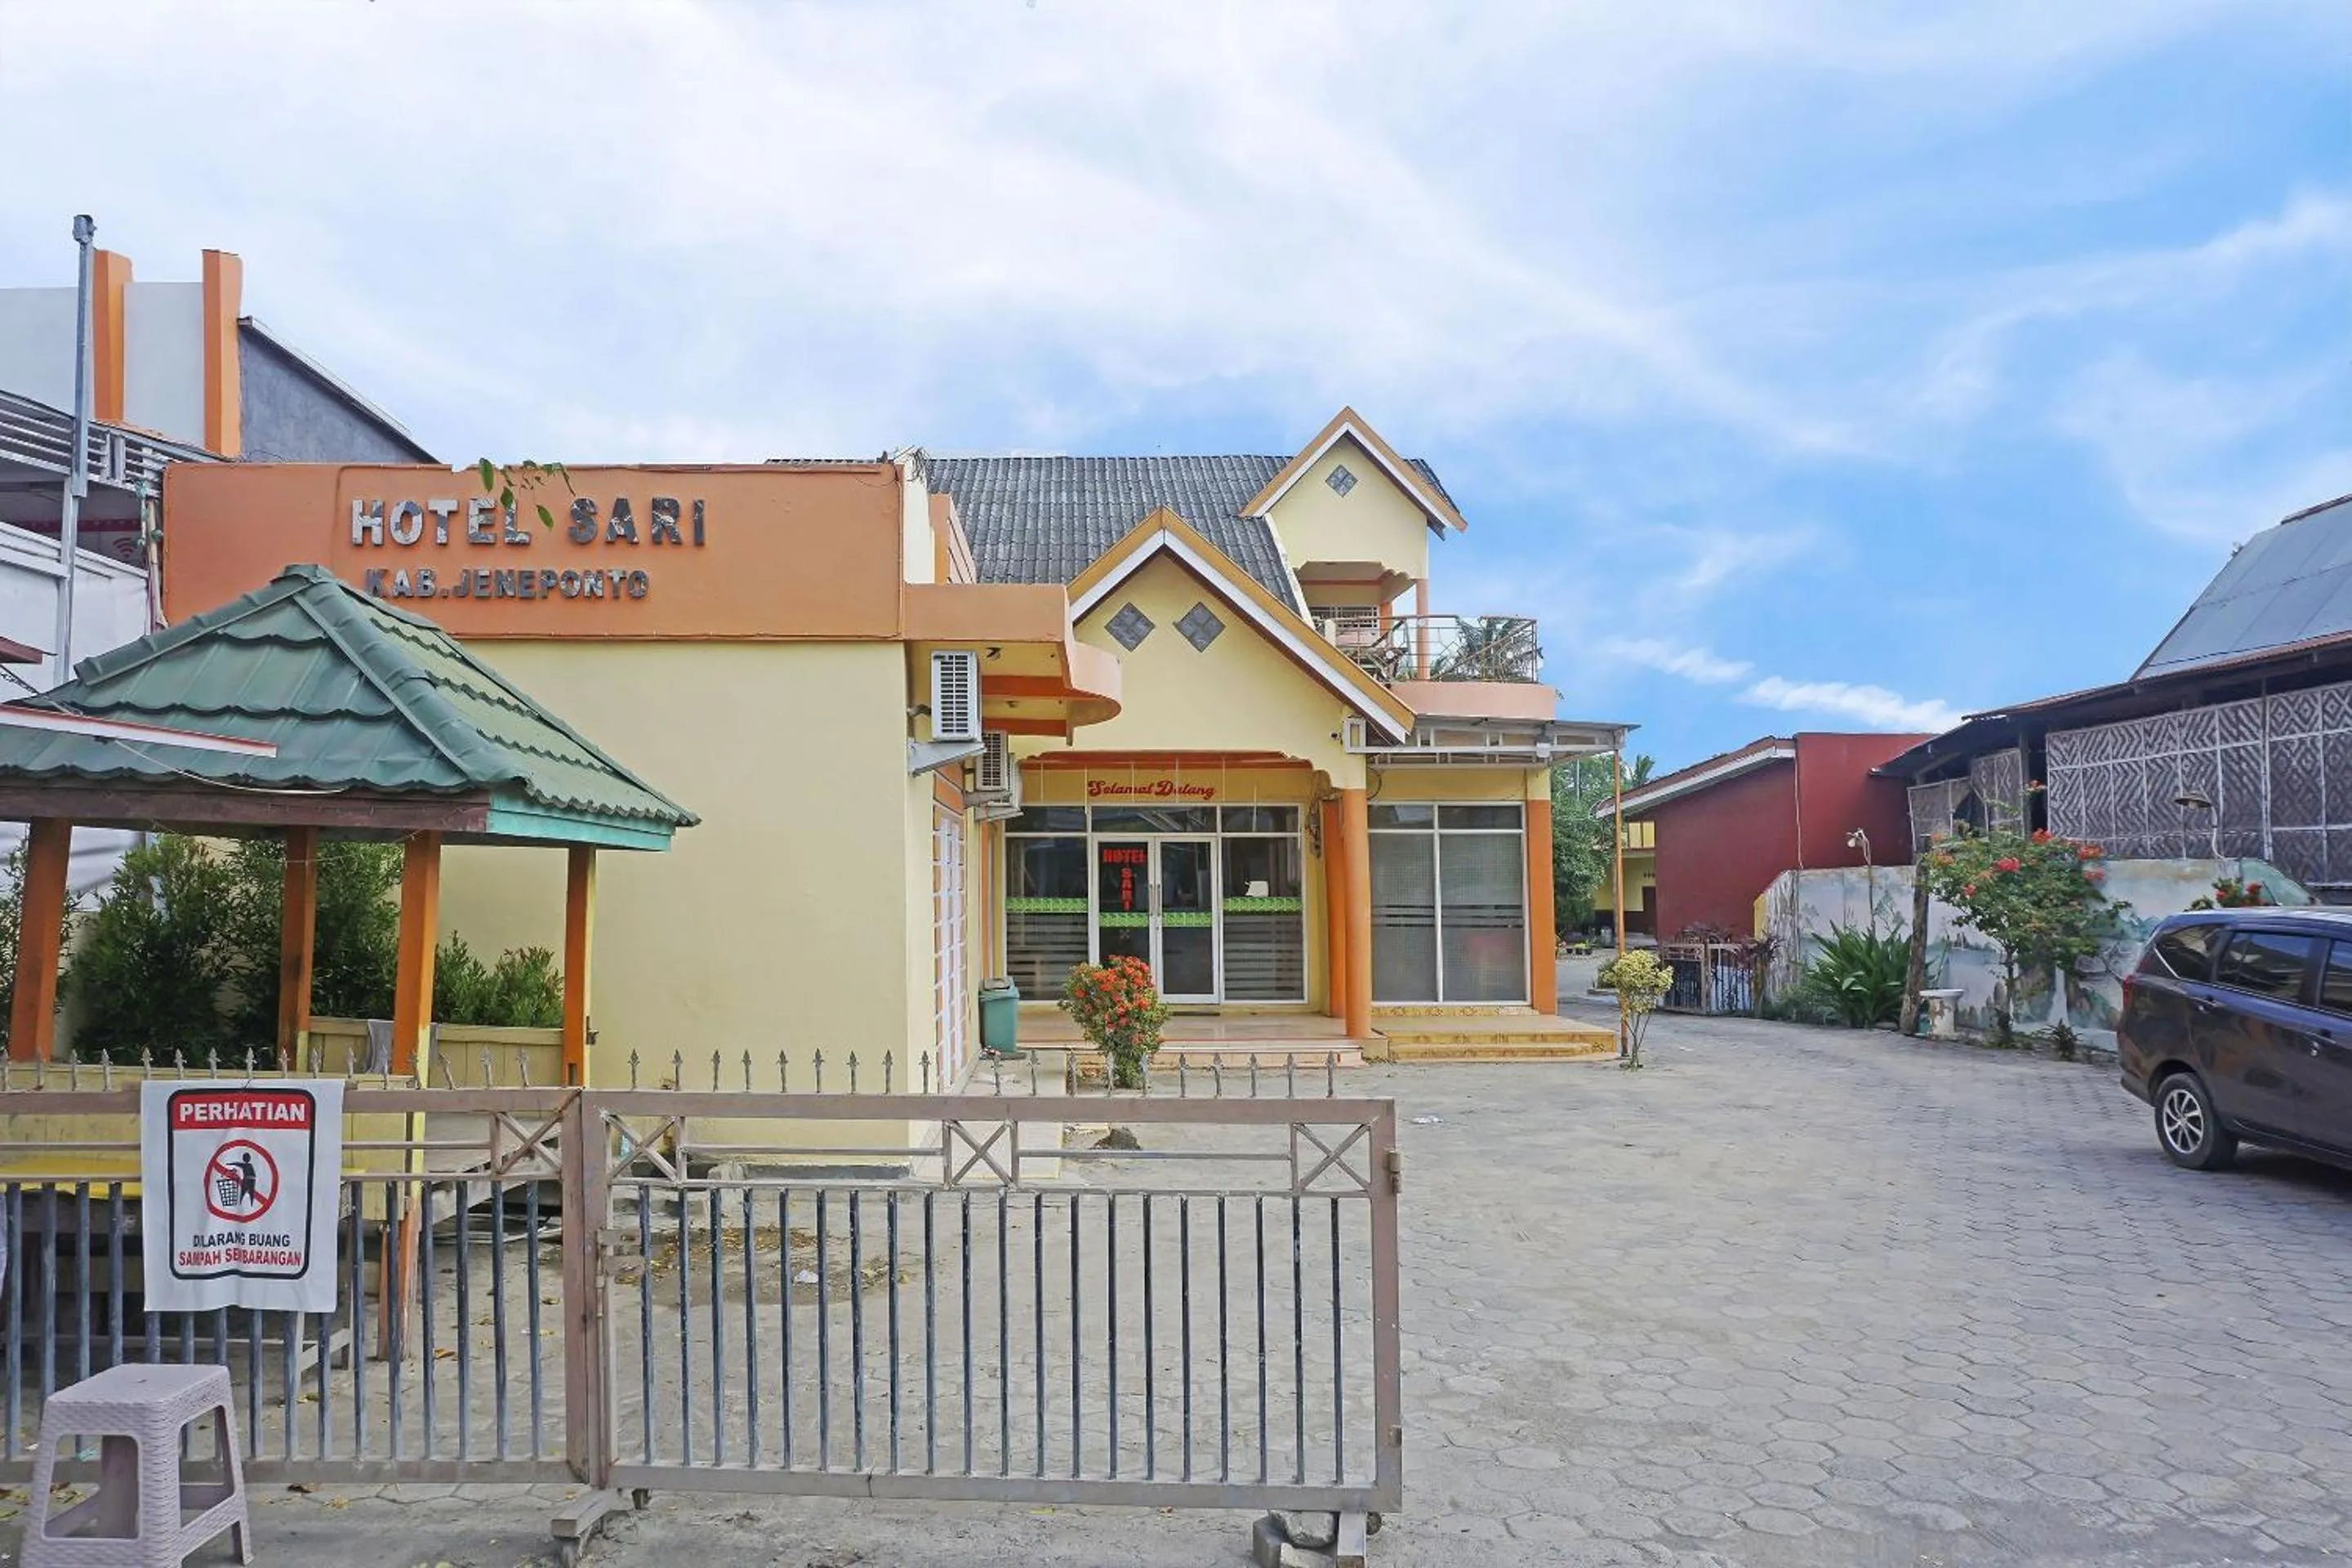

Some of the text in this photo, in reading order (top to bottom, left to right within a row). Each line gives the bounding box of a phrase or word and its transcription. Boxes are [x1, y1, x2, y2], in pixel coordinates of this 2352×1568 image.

[352, 497, 706, 546] HOTEL SARI
[1088, 779, 1215, 800] Selamat Datang
[1103, 849, 1147, 863] HOTEL
[180, 1102, 305, 1122] PERHATIAN
[193, 1232, 291, 1248] DILARANG BUANG
[178, 1250, 222, 1266] SAMPAH
